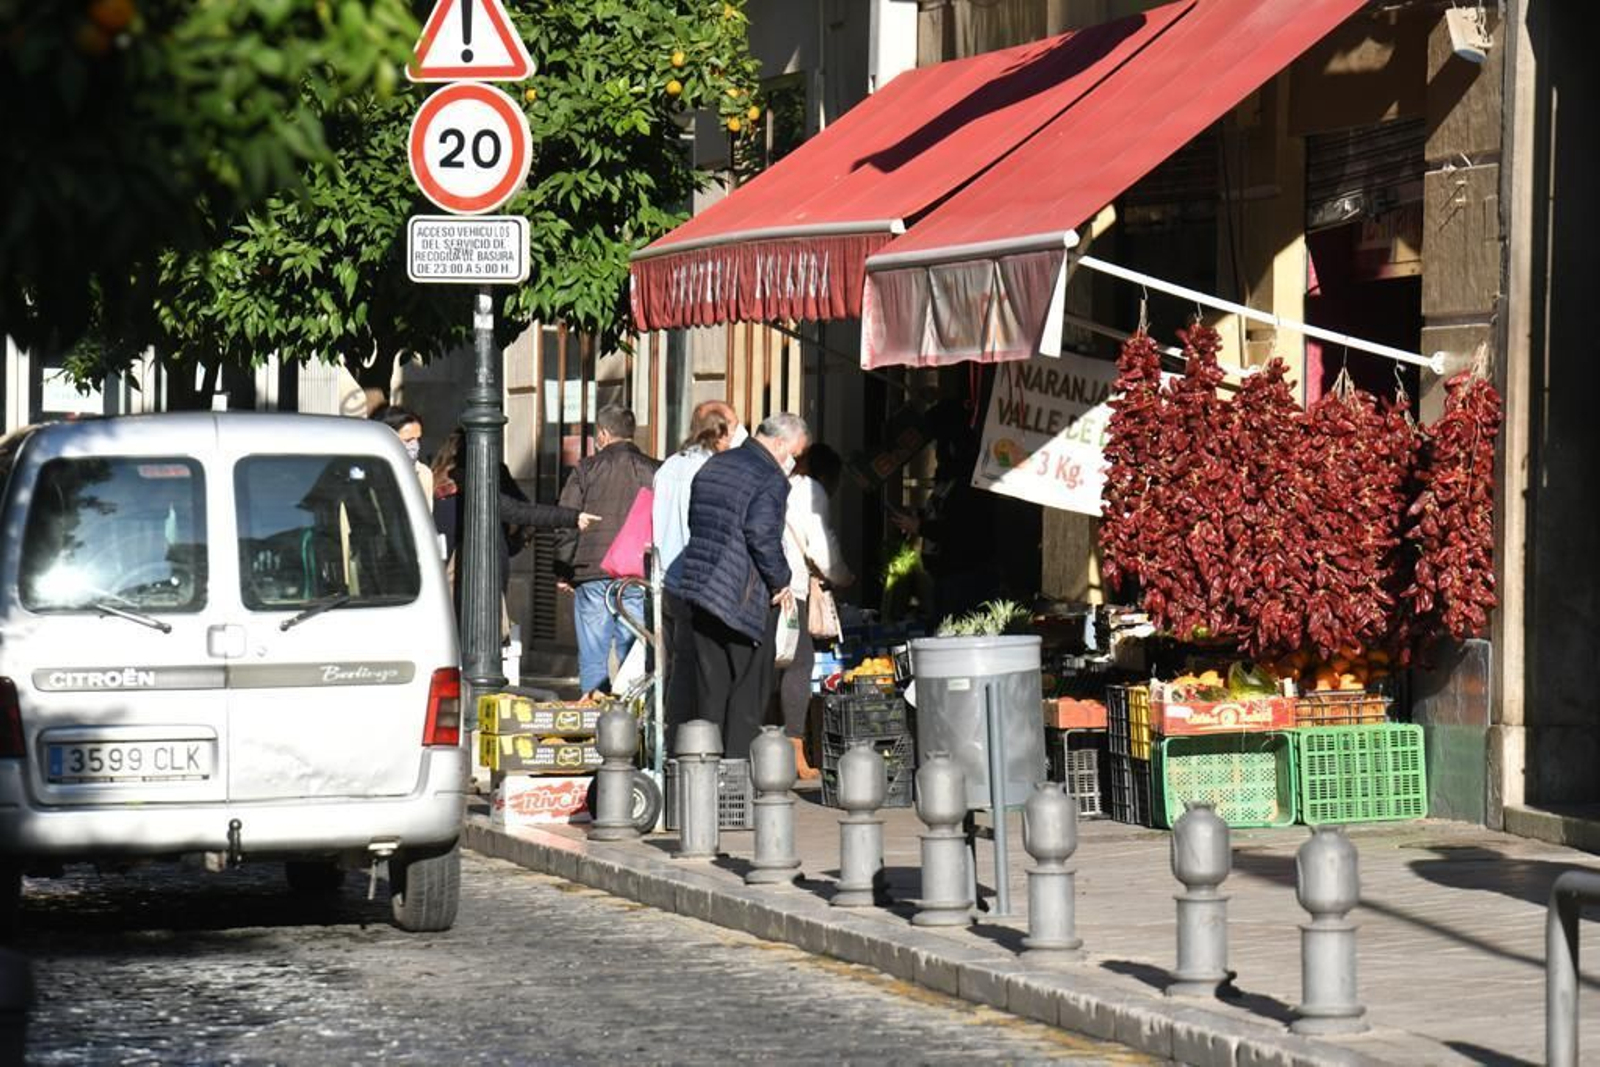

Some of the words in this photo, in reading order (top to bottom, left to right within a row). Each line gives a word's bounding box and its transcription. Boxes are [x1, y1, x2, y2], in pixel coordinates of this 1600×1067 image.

[439, 128, 501, 169] 20
[417, 226, 455, 238] ACCESO
[457, 226, 510, 238] VEHICULOS
[422, 238, 439, 249] DEL
[443, 238, 491, 250] SERVICIO
[493, 239, 505, 249] DE
[477, 250, 514, 261] BASURA
[417, 263, 430, 274] DE
[433, 263, 463, 274] 23:00
[465, 263, 473, 274] A
[475, 263, 498, 274] 5:00
[997, 396, 1061, 437] VALLE
[1065, 414, 1096, 444] DE
[1037, 451, 1050, 476] 3
[1055, 454, 1085, 490] Kg.
[50, 667, 155, 687] CITROËN
[320, 664, 399, 683] Berlingo
[69, 748, 143, 773] 3599
[154, 745, 200, 771] CLK
[524, 788, 587, 809] Rivoi
